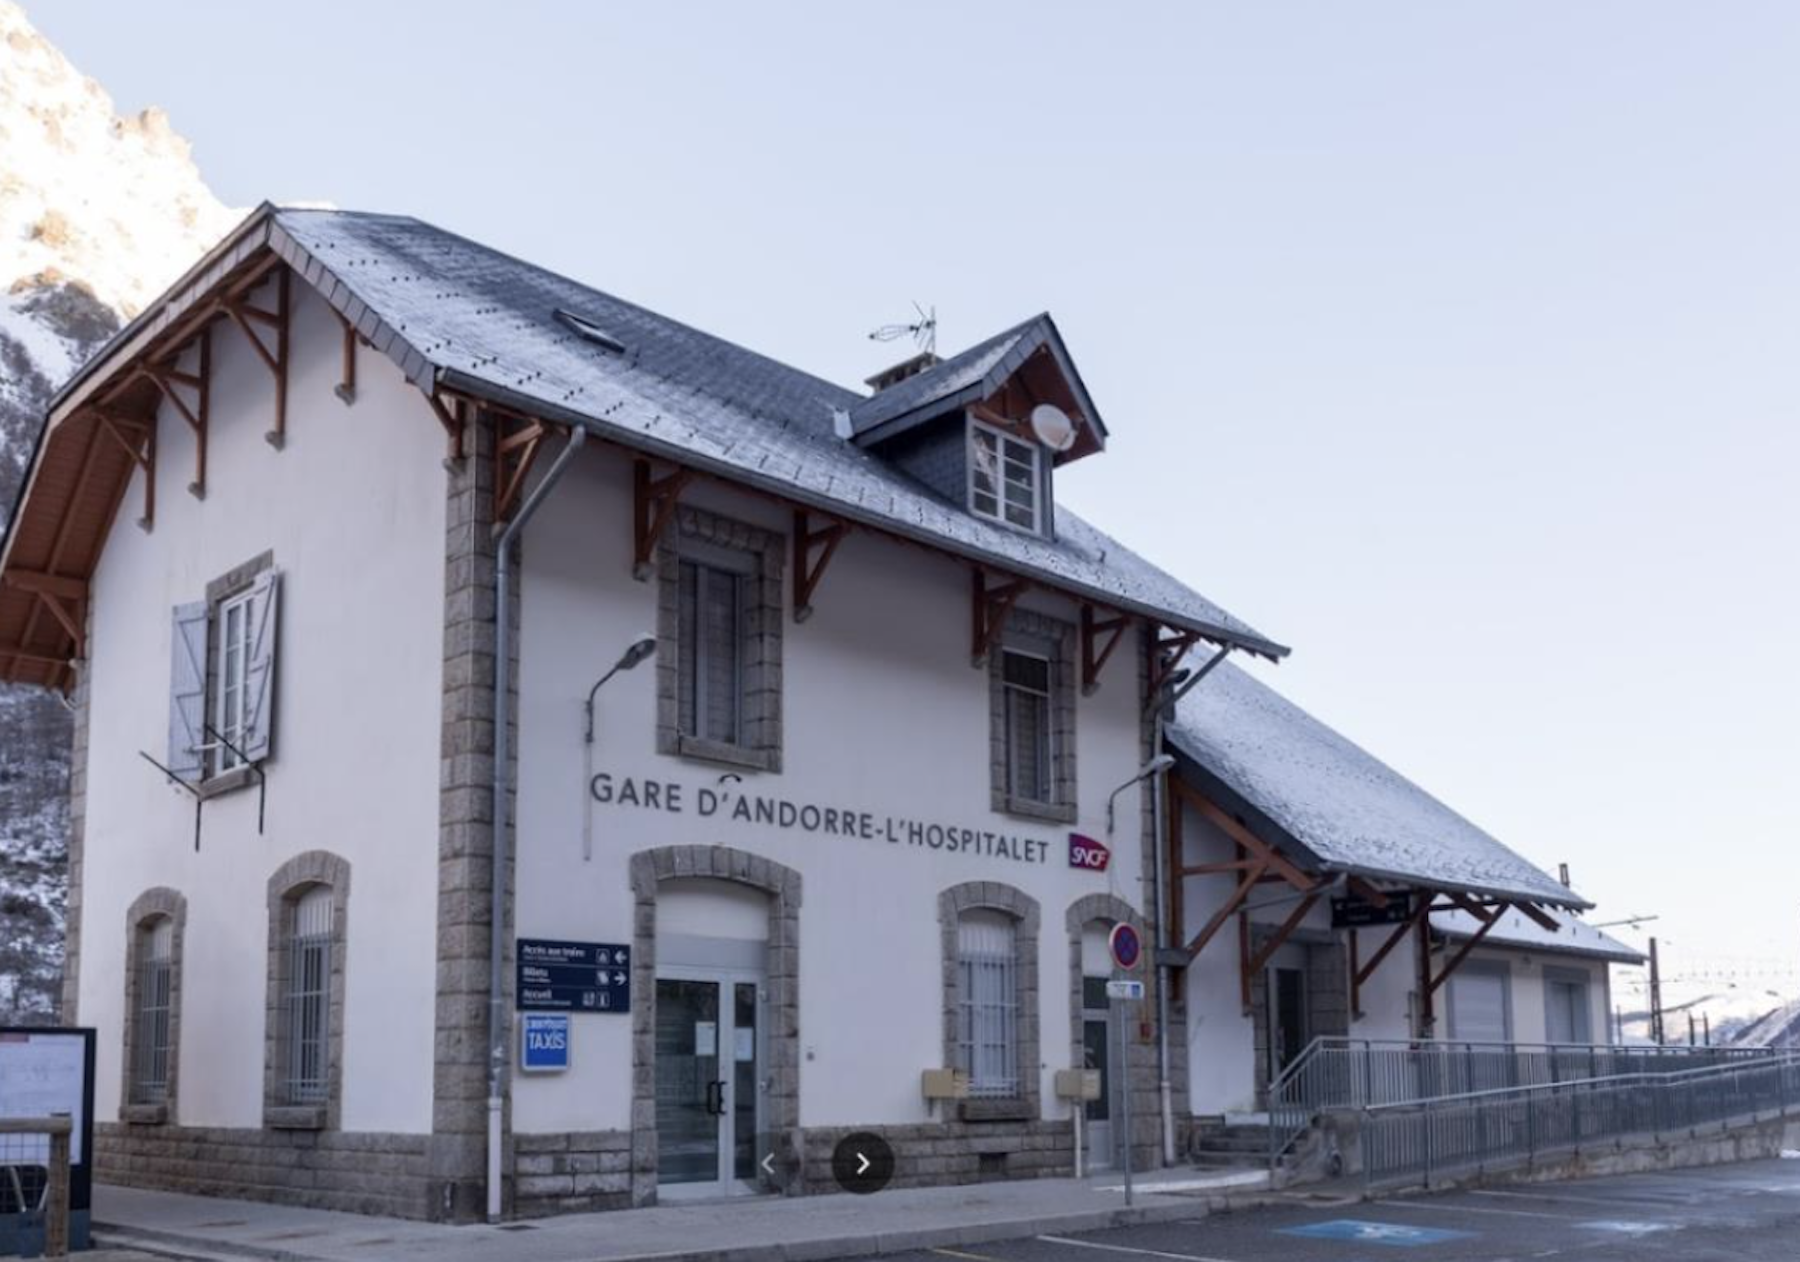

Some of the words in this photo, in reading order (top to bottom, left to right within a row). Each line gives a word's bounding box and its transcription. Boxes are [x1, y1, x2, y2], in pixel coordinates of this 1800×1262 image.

[590, 773, 682, 813] GARE
[1071, 846, 1106, 867] SNCF
[528, 1032, 565, 1050] TAXIS
